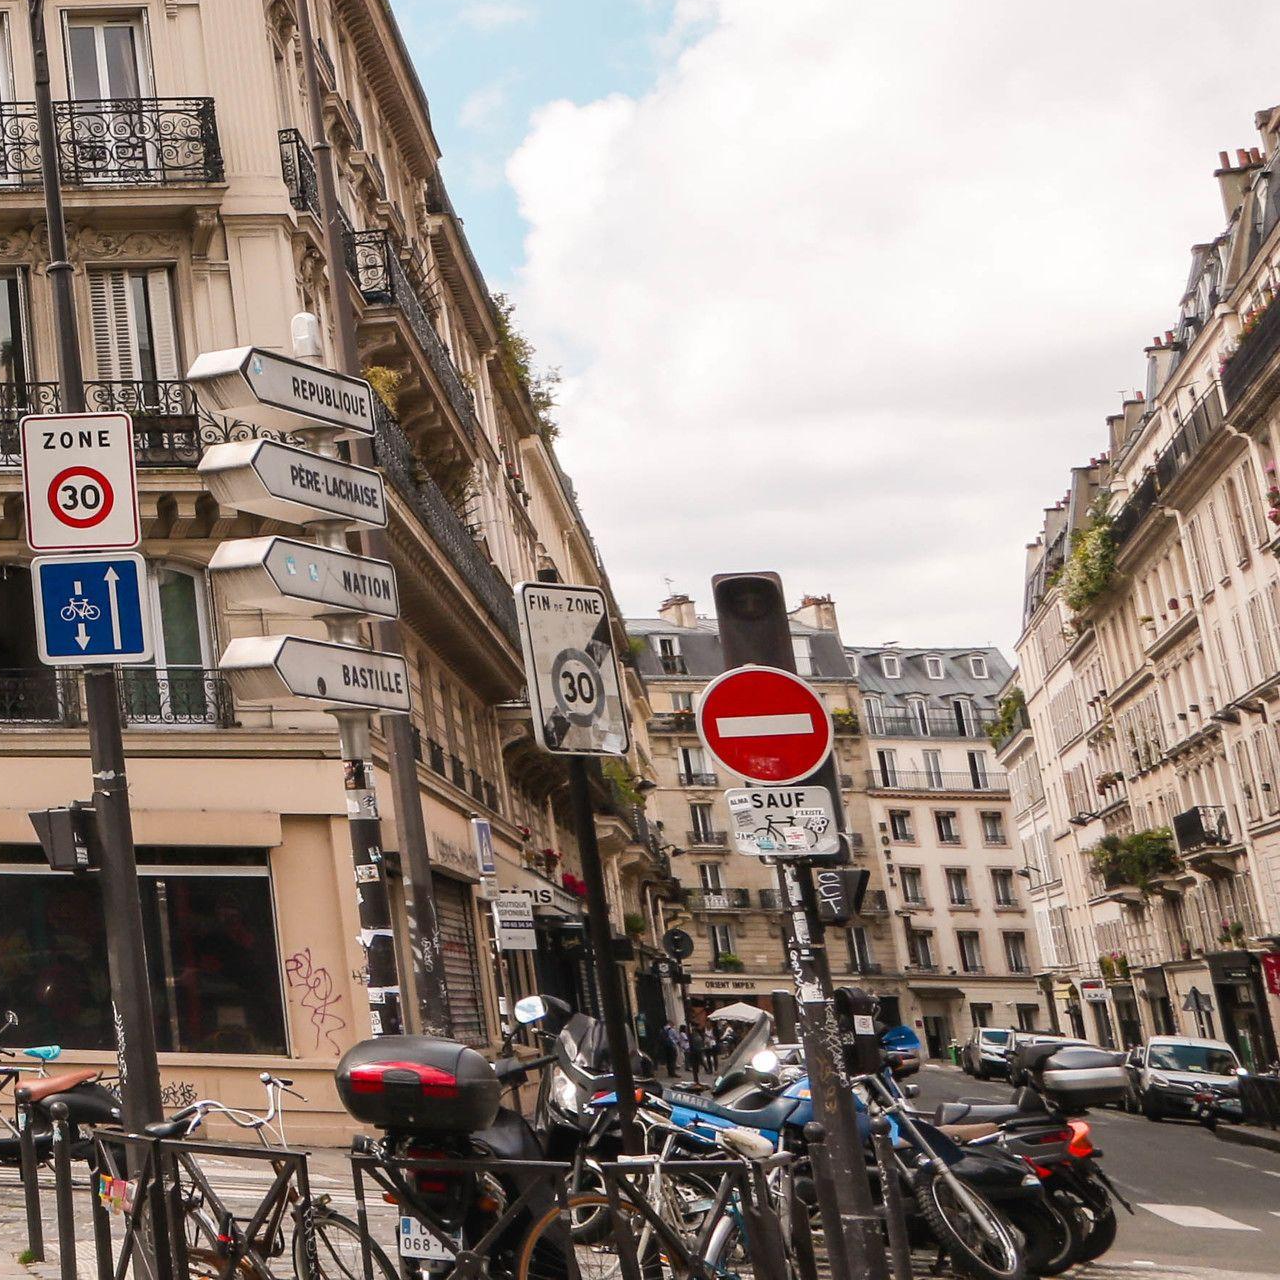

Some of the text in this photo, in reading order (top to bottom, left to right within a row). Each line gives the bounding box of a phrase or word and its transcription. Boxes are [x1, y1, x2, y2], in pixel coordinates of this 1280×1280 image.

[42, 430, 111, 450] ZONE
[61, 484, 101, 511] 30
[342, 569, 391, 600] NATION
[528, 594, 551, 611] FIN
[566, 597, 602, 615] ZONE
[341, 664, 403, 694] BASTILLE
[560, 670, 595, 704] 30
[751, 792, 806, 809] SAUF
[704, 981, 730, 989] ORIENT
